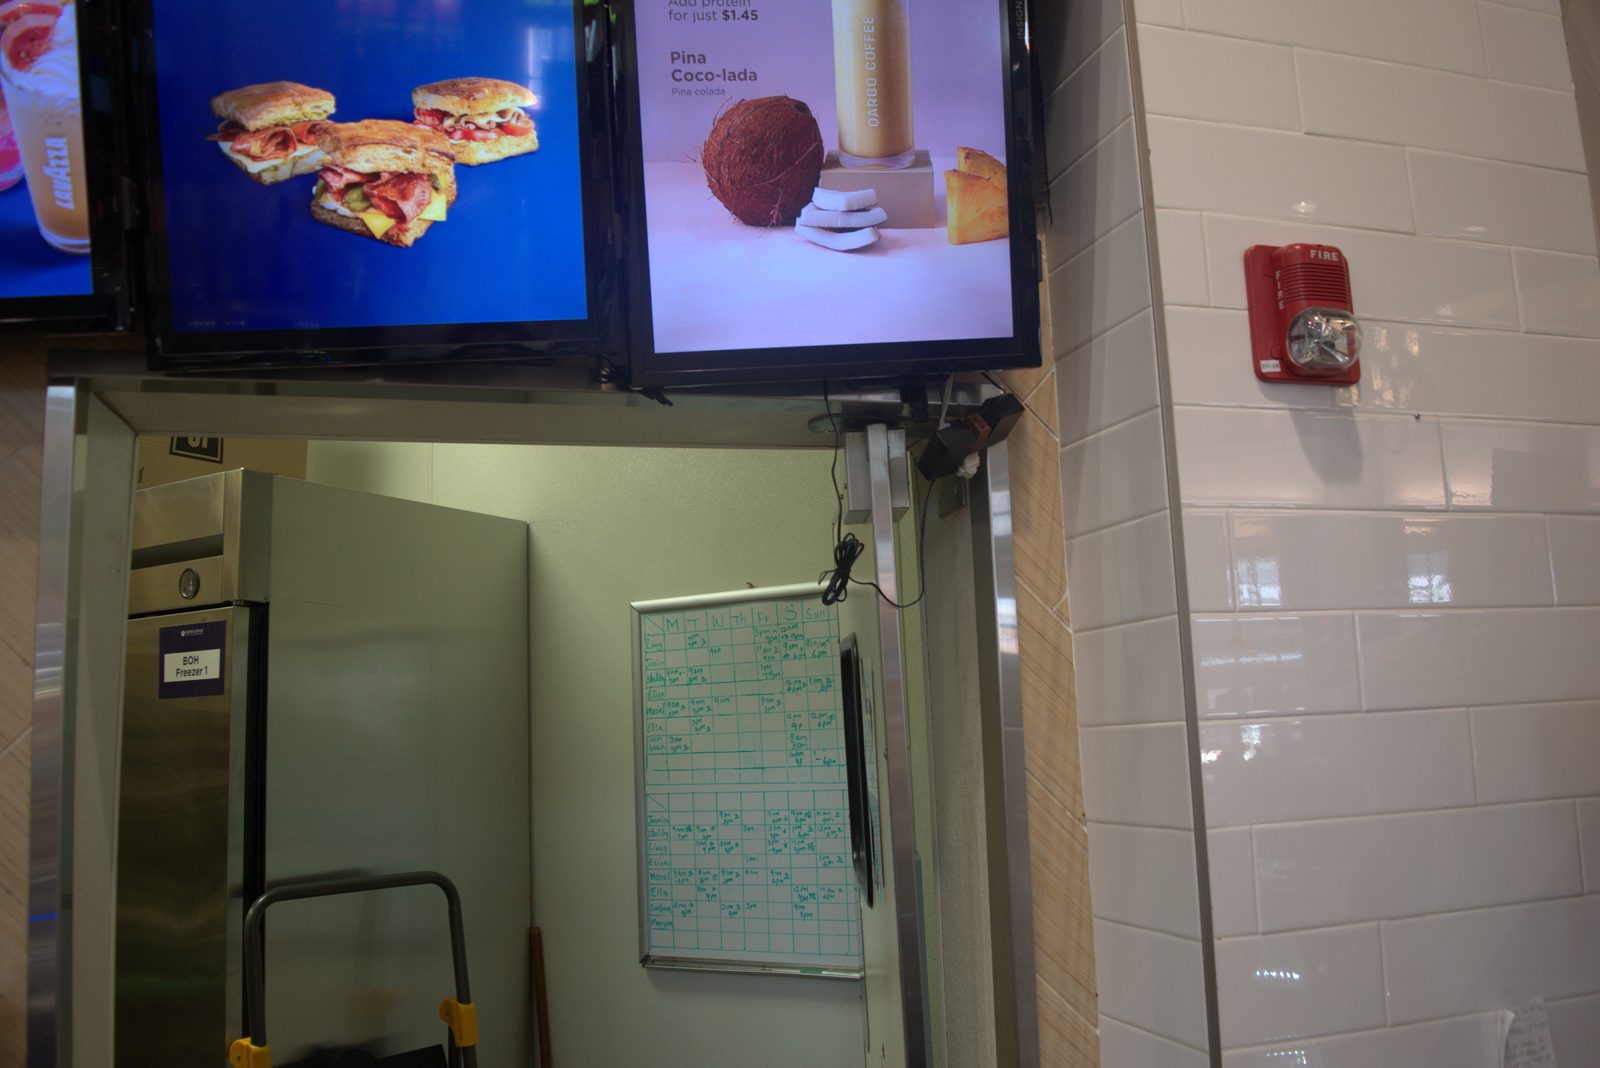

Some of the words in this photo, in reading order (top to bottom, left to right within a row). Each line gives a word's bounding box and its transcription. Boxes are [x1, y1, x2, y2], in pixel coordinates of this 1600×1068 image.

[668, 9, 688, 21] for
[692, 9, 717, 23] just
[722, 9, 758, 21] $1.45
[863, 16, 876, 71] COFFEE
[670, 51, 706, 64] Pina
[671, 68, 757, 82] Coco-lada
[671, 87, 692, 96] Pina
[694, 87, 726, 96] colada
[43, 136, 74, 210] LAVAZZA
[1310, 249, 1339, 261] FIRE
[1275, 271, 1285, 310] FIRE
[182, 656, 199, 666] BOH
[175, 667, 203, 677] Freezer
[204, 666, 208, 675] 1
